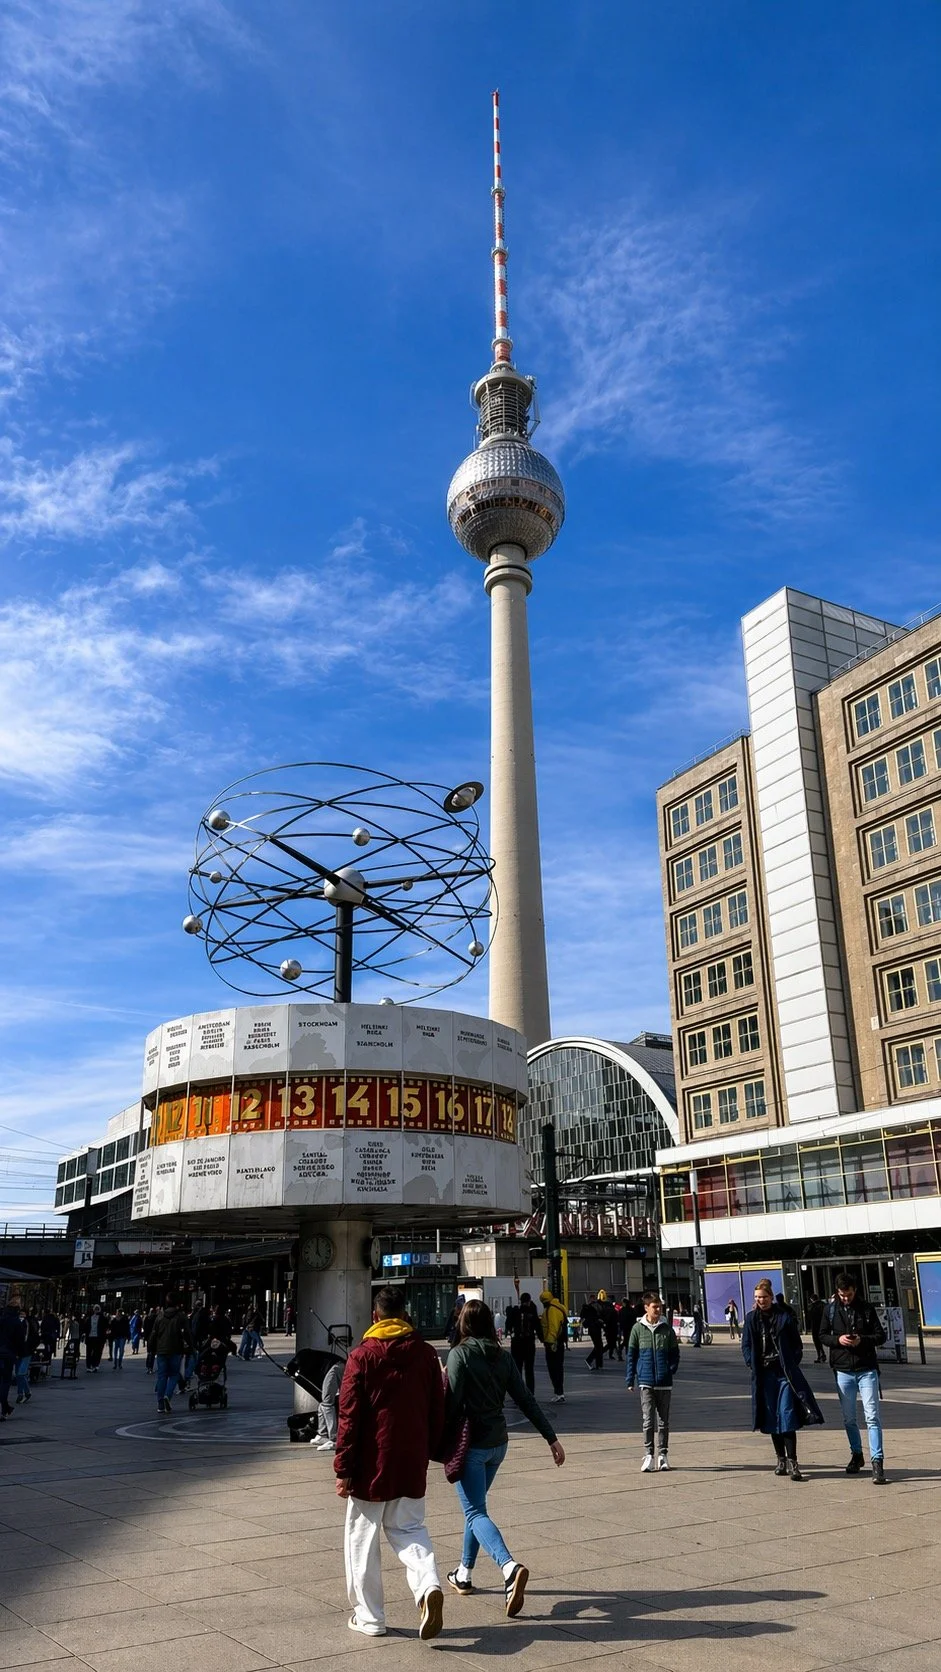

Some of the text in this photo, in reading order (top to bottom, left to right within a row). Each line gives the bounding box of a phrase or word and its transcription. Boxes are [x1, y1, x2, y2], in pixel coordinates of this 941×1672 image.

[230, 1089, 262, 1121] 12
[277, 1085, 315, 1117] 13
[331, 1085, 370, 1116] 14
[386, 1086, 421, 1118] 15
[435, 1090, 465, 1121] 16
[474, 1095, 495, 1126] 17
